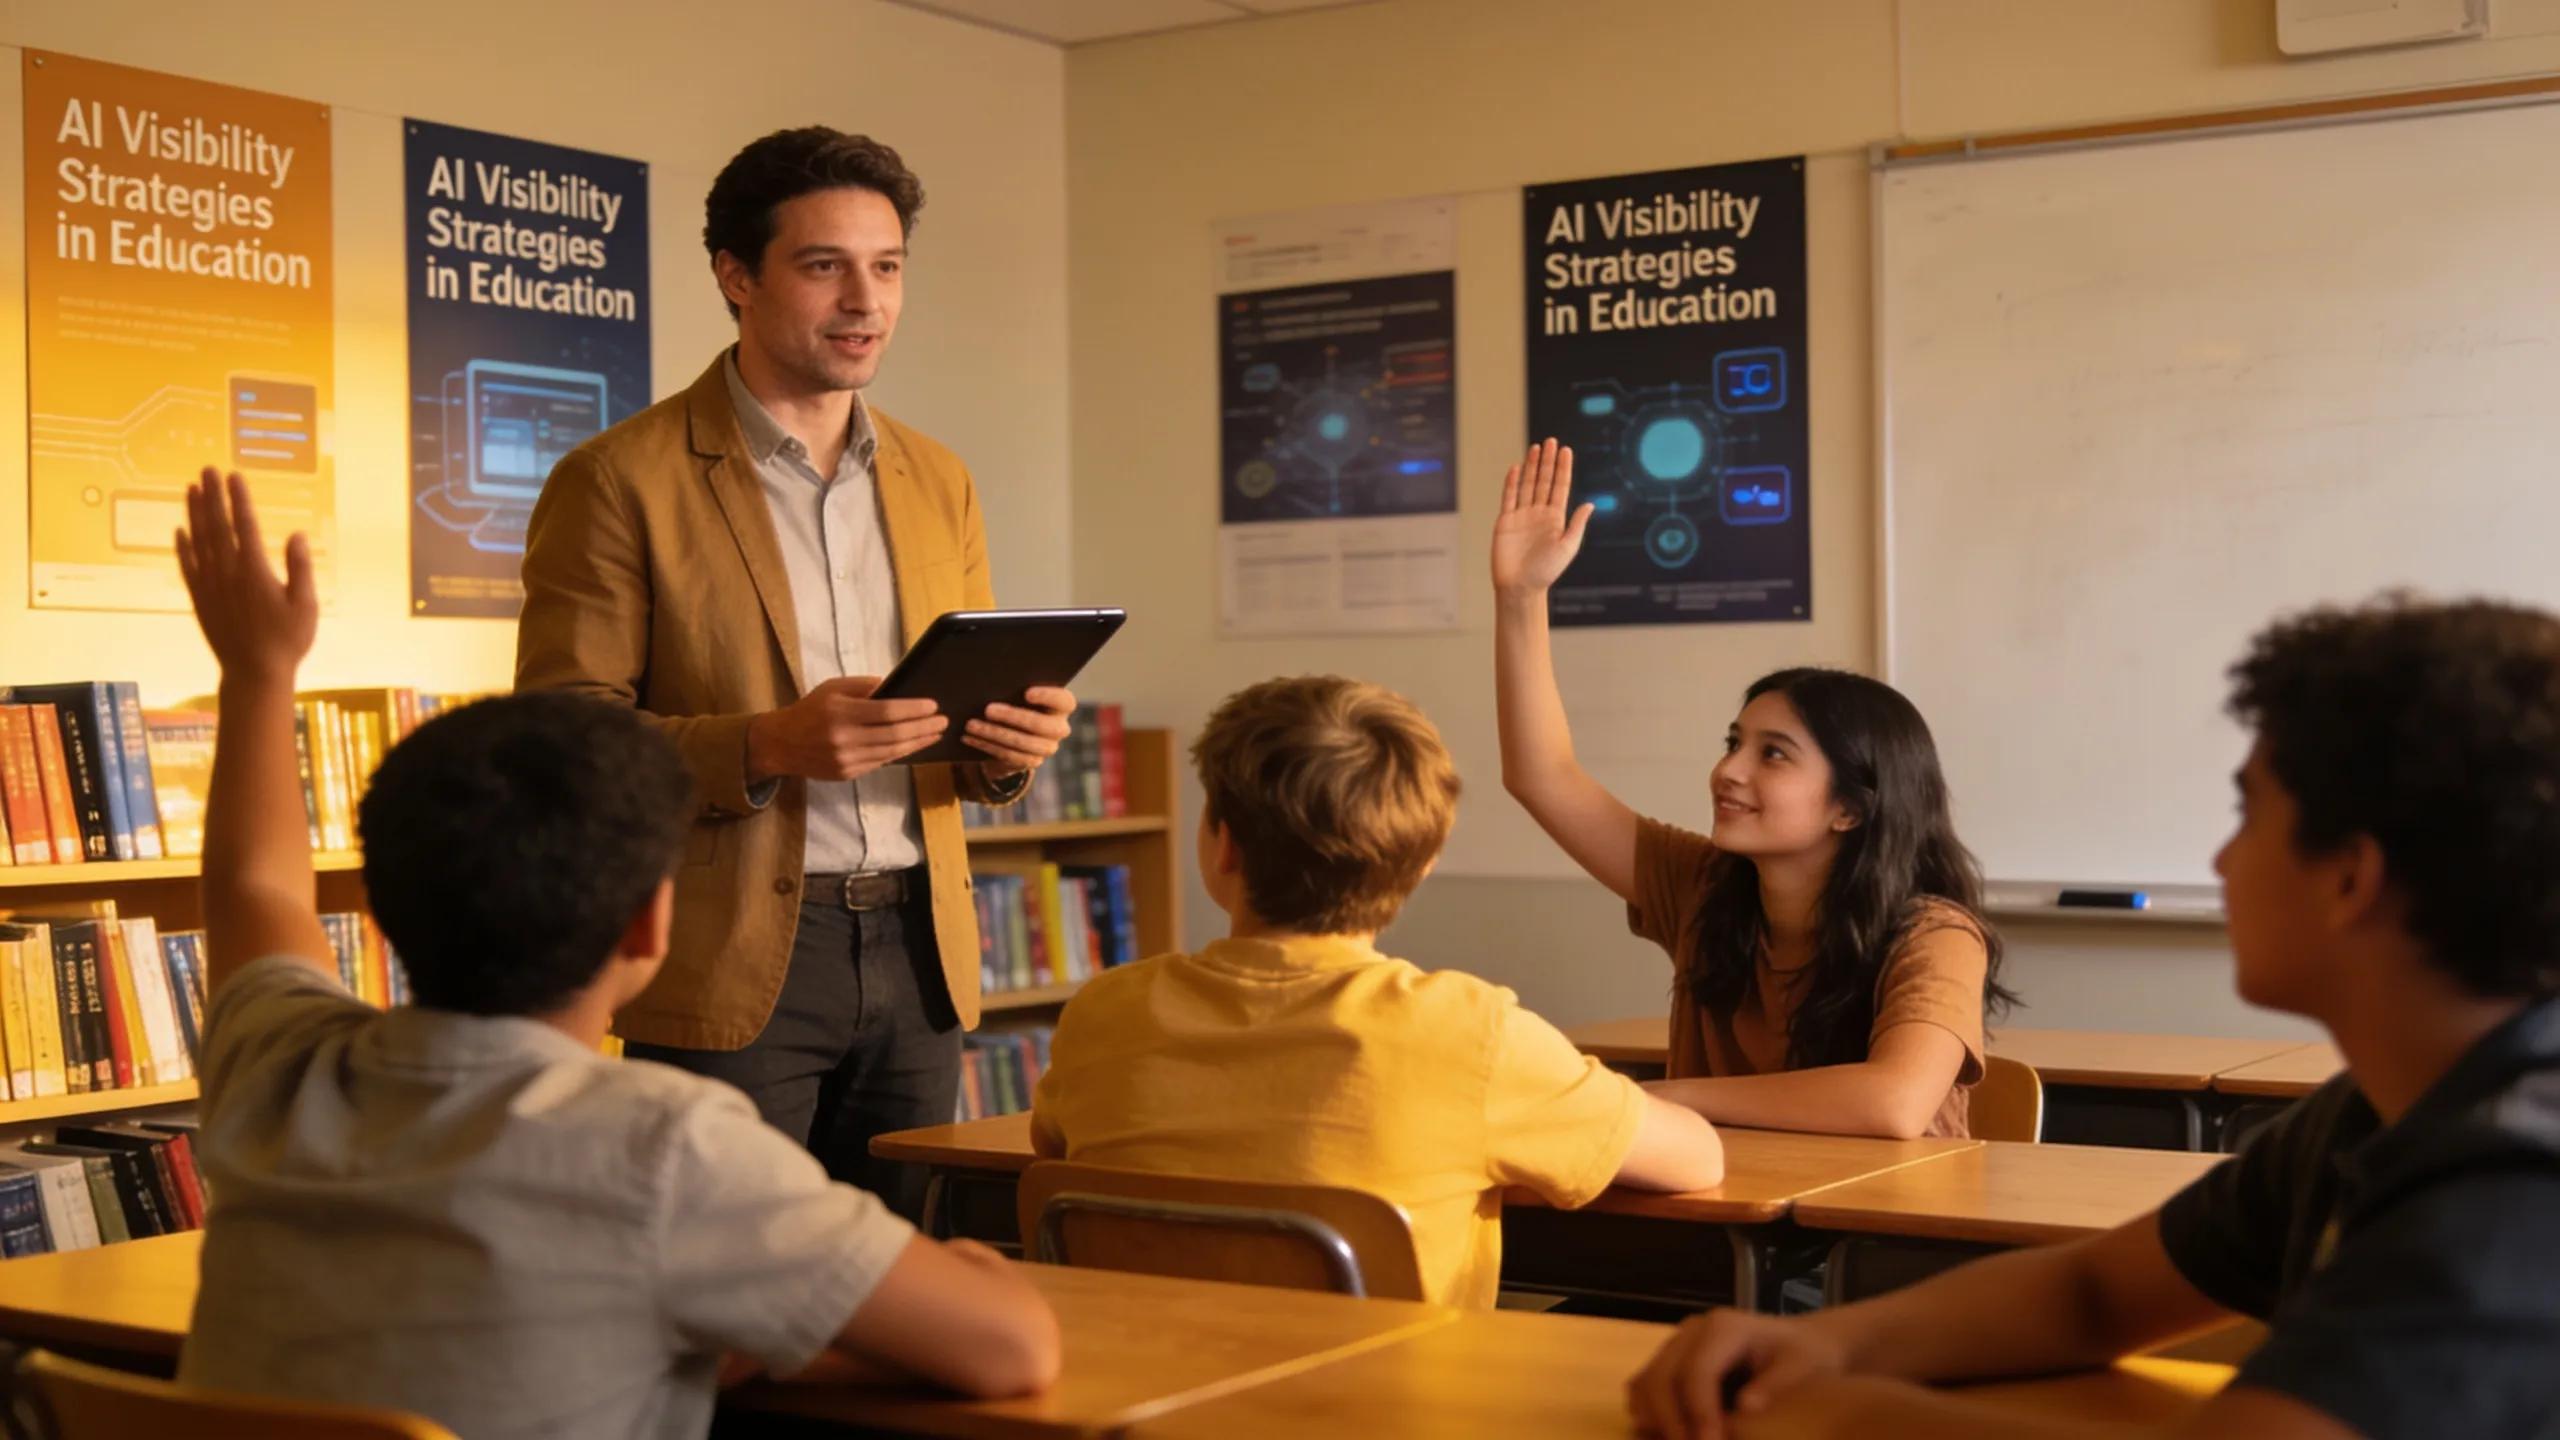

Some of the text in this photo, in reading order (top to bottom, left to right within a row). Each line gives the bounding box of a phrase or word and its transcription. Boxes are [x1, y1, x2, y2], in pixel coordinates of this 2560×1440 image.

[57, 98, 293, 189] AI Visibility
[57, 157, 273, 233] Strategies
[427, 156, 622, 233] AI Visibility
[1546, 190, 1760, 244] AI Visibility
[57, 210, 311, 289] in Education
[426, 207, 606, 273] Strategies
[1545, 241, 1736, 289] Strategies
[426, 255, 635, 321] in Education
[1545, 283, 1776, 335] in Education
